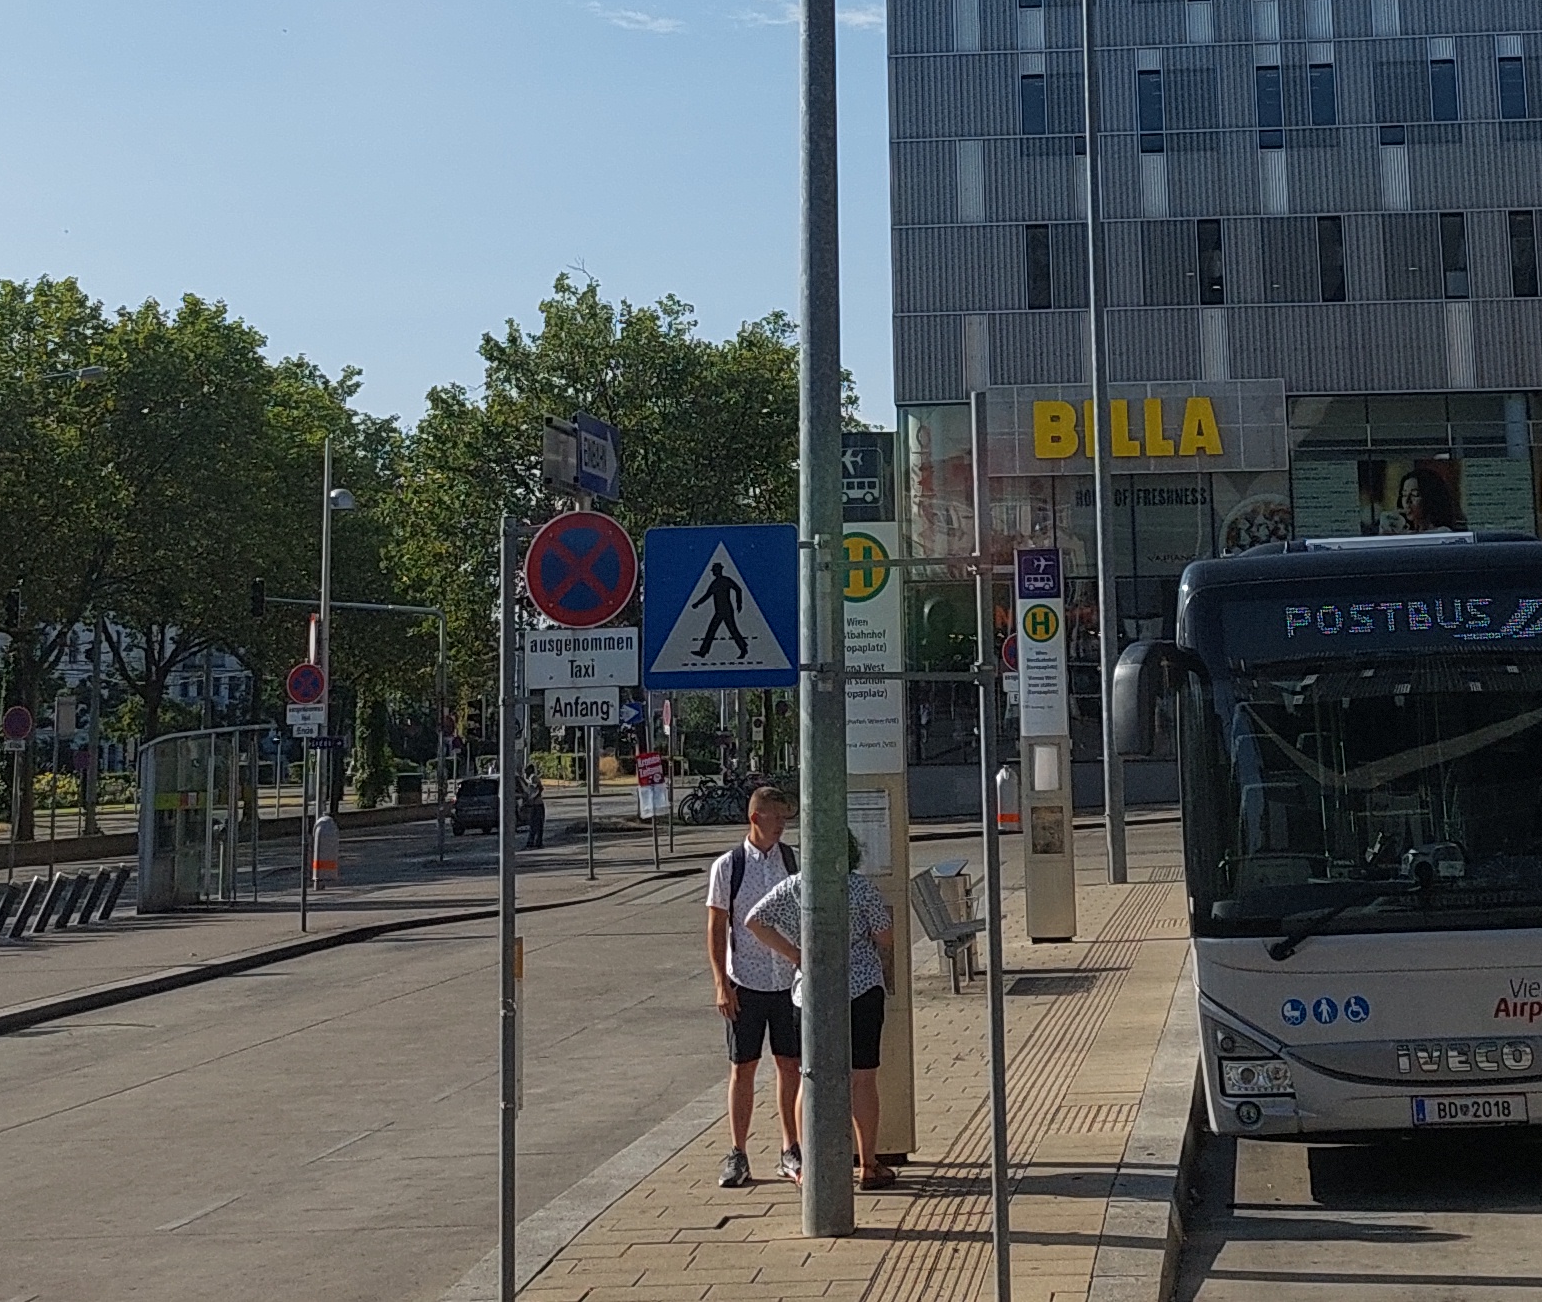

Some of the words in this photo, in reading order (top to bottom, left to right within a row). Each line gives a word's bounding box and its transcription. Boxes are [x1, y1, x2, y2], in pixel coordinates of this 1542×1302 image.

[1032, 396, 1224, 459] BILLA
[1114, 489, 1128, 506] OF
[1136, 487, 1207, 506] FRESHNESS
[846, 617, 868, 626] Wien
[1285, 598, 1493, 638] POSTBUS
[529, 635, 633, 657] ausgenommen
[567, 659, 596, 679] Taxi
[863, 663, 885, 672] West
[551, 695, 611, 722] Anfang
[1396, 1040, 1534, 1074] IVECO
